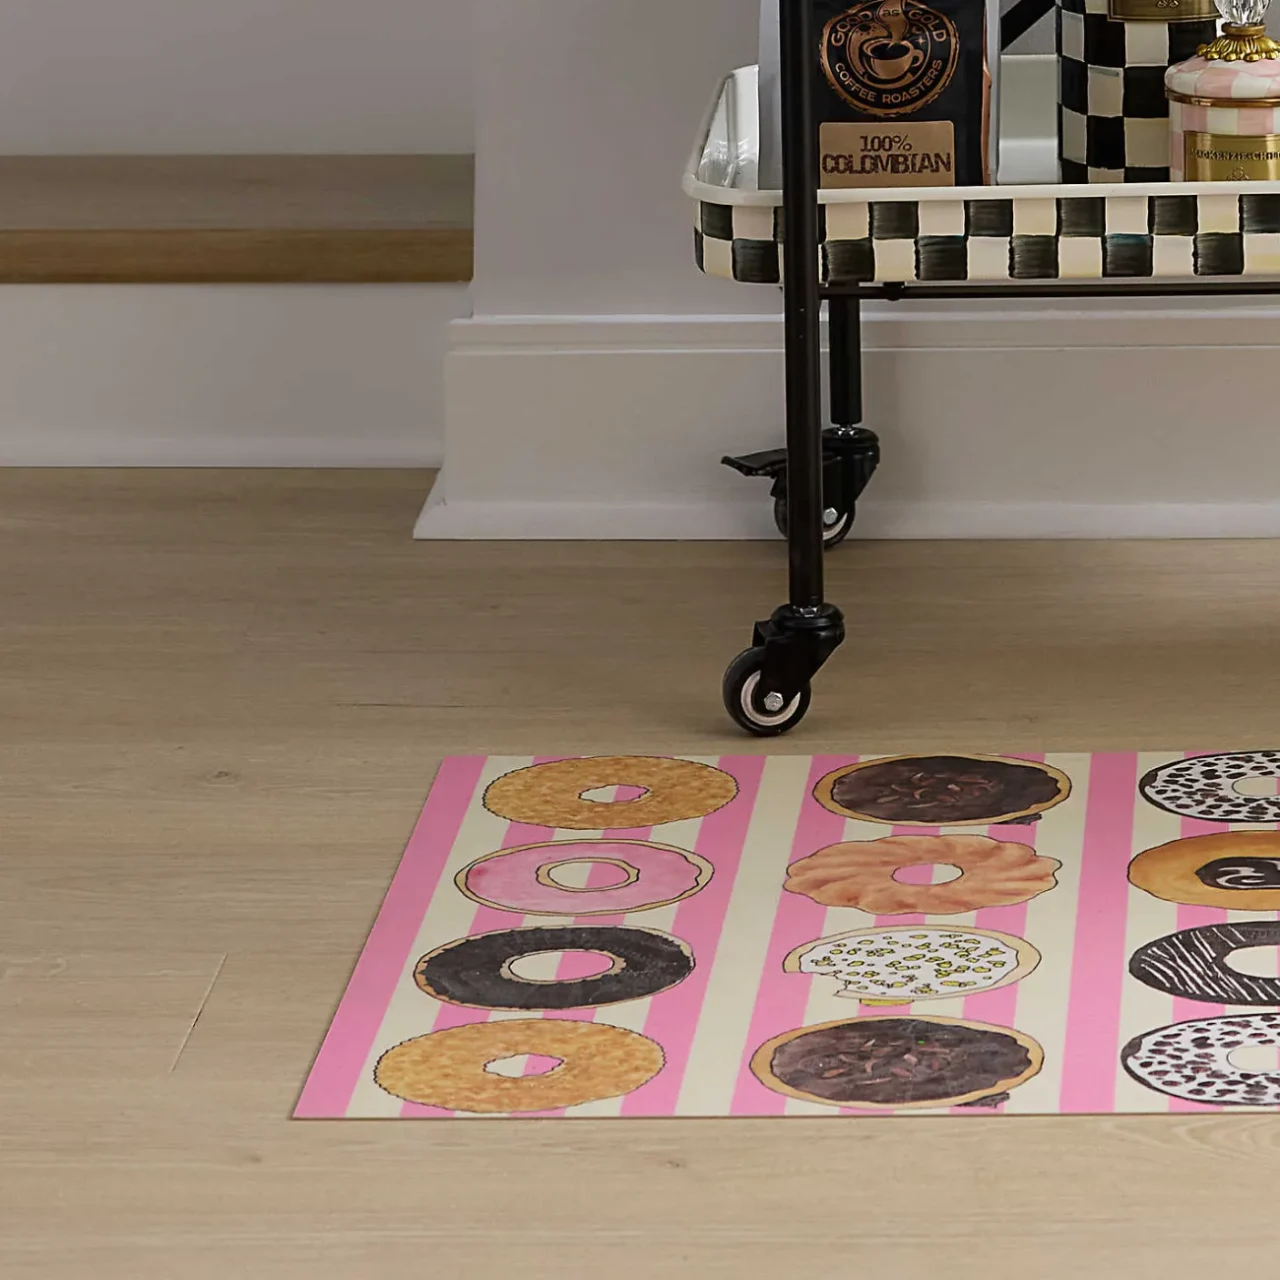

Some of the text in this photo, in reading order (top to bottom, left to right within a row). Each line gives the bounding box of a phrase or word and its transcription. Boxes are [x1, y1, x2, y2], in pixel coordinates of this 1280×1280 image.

[831, 10, 946, 46] GOOD as GOLD
[836, 60, 942, 104] COFFEE ROASTERS
[860, 134, 912, 152] 100%
[822, 152, 952, 174] COLOMBIAN
